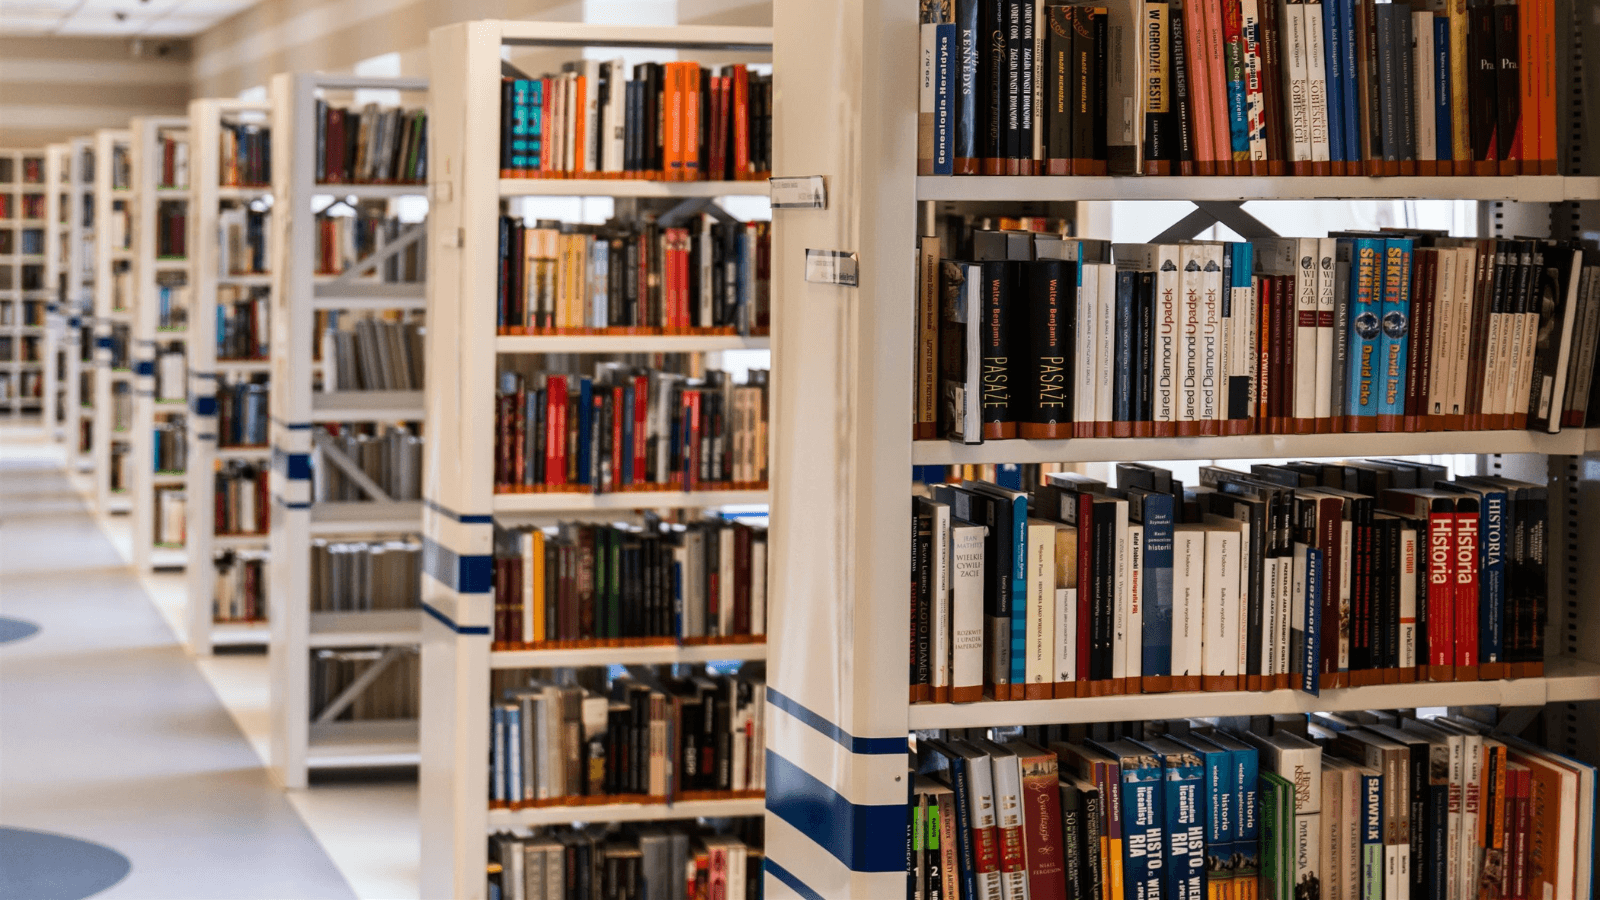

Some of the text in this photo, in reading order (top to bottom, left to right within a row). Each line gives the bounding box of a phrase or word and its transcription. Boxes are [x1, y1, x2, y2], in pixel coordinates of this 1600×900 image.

[1010, 2, 1019, 40] ANDREW COOK
[1024, 2, 1033, 40] ANDREW COOK
[963, 29, 971, 95] KENNEDYS
[1149, 9, 1161, 110] W OGRODZIE BESTII
[1173, 18, 1186, 97] SZEŚĆ PIĘTER LUKSUSU
[1232, 35, 1240, 65] Fryderyk
[1247, 17, 1257, 88] TAJEMNICE WINDSORÓW
[1331, 42, 1339, 78] Bonapartych
[1292, 79, 1303, 144] SOBIESKICH
[1311, 79, 1321, 144] SOBIESKICH
[1358, 247, 1373, 305] SEKRET
[1373, 252, 1382, 302] NAJWIĘKSZY
[1385, 247, 1401, 304] SEKRET
[1401, 252, 1410, 301] NAJWIĘKSZY
[991, 279, 1000, 347] Walter Benjamin
[1048, 279, 1058, 347] Walter Benjamin
[1160, 288, 1175, 421] Jared Diamond Upadek
[1184, 288, 1199, 421] Jared Diamond Upadek
[1203, 288, 1217, 421] Jared Diamond Upadek
[1261, 352, 1269, 404] CYWILIZACJE
[1360, 345, 1372, 405] David Icke
[1387, 343, 1400, 404] David Icke
[984, 357, 1011, 409] PASAŻE
[1040, 356, 1067, 408] PASAŻE
[1406, 540, 1414, 574] HISTORIA
[1431, 518, 1452, 584] Historia
[1457, 518, 1477, 584] Historia
[1488, 498, 1501, 566] HISTORIA
[920, 600, 929, 633] ZŁOTO
[1305, 552, 1317, 691] Historia powszechna
[1087, 798, 1096, 812] 50
[1112, 783, 1120, 822] repetytorium
[1136, 786, 1147, 826] licealisty
[1146, 786, 1154, 826] Kompendium
[1178, 784, 1189, 824] licealisty
[1188, 784, 1196, 823] Kompendium
[1221, 793, 1230, 831] historia
[1246, 791, 1255, 829] historia
[1294, 765, 1304, 810] KISSINGER
[1303, 771, 1311, 803] HENRY
[1037, 793, 1051, 843] Cywilizacja
[1066, 811, 1076, 825] 50
[1237, 791, 1245, 837] społeczeństwie
[1129, 834, 1147, 859] RIA
[1147, 827, 1163, 870] HISTO
[1171, 832, 1188, 856] RIA
[1188, 825, 1204, 868] HISTO
[1299, 820, 1307, 870] DYPLOMACJA
[1033, 867, 1062, 876] FERGUSON
